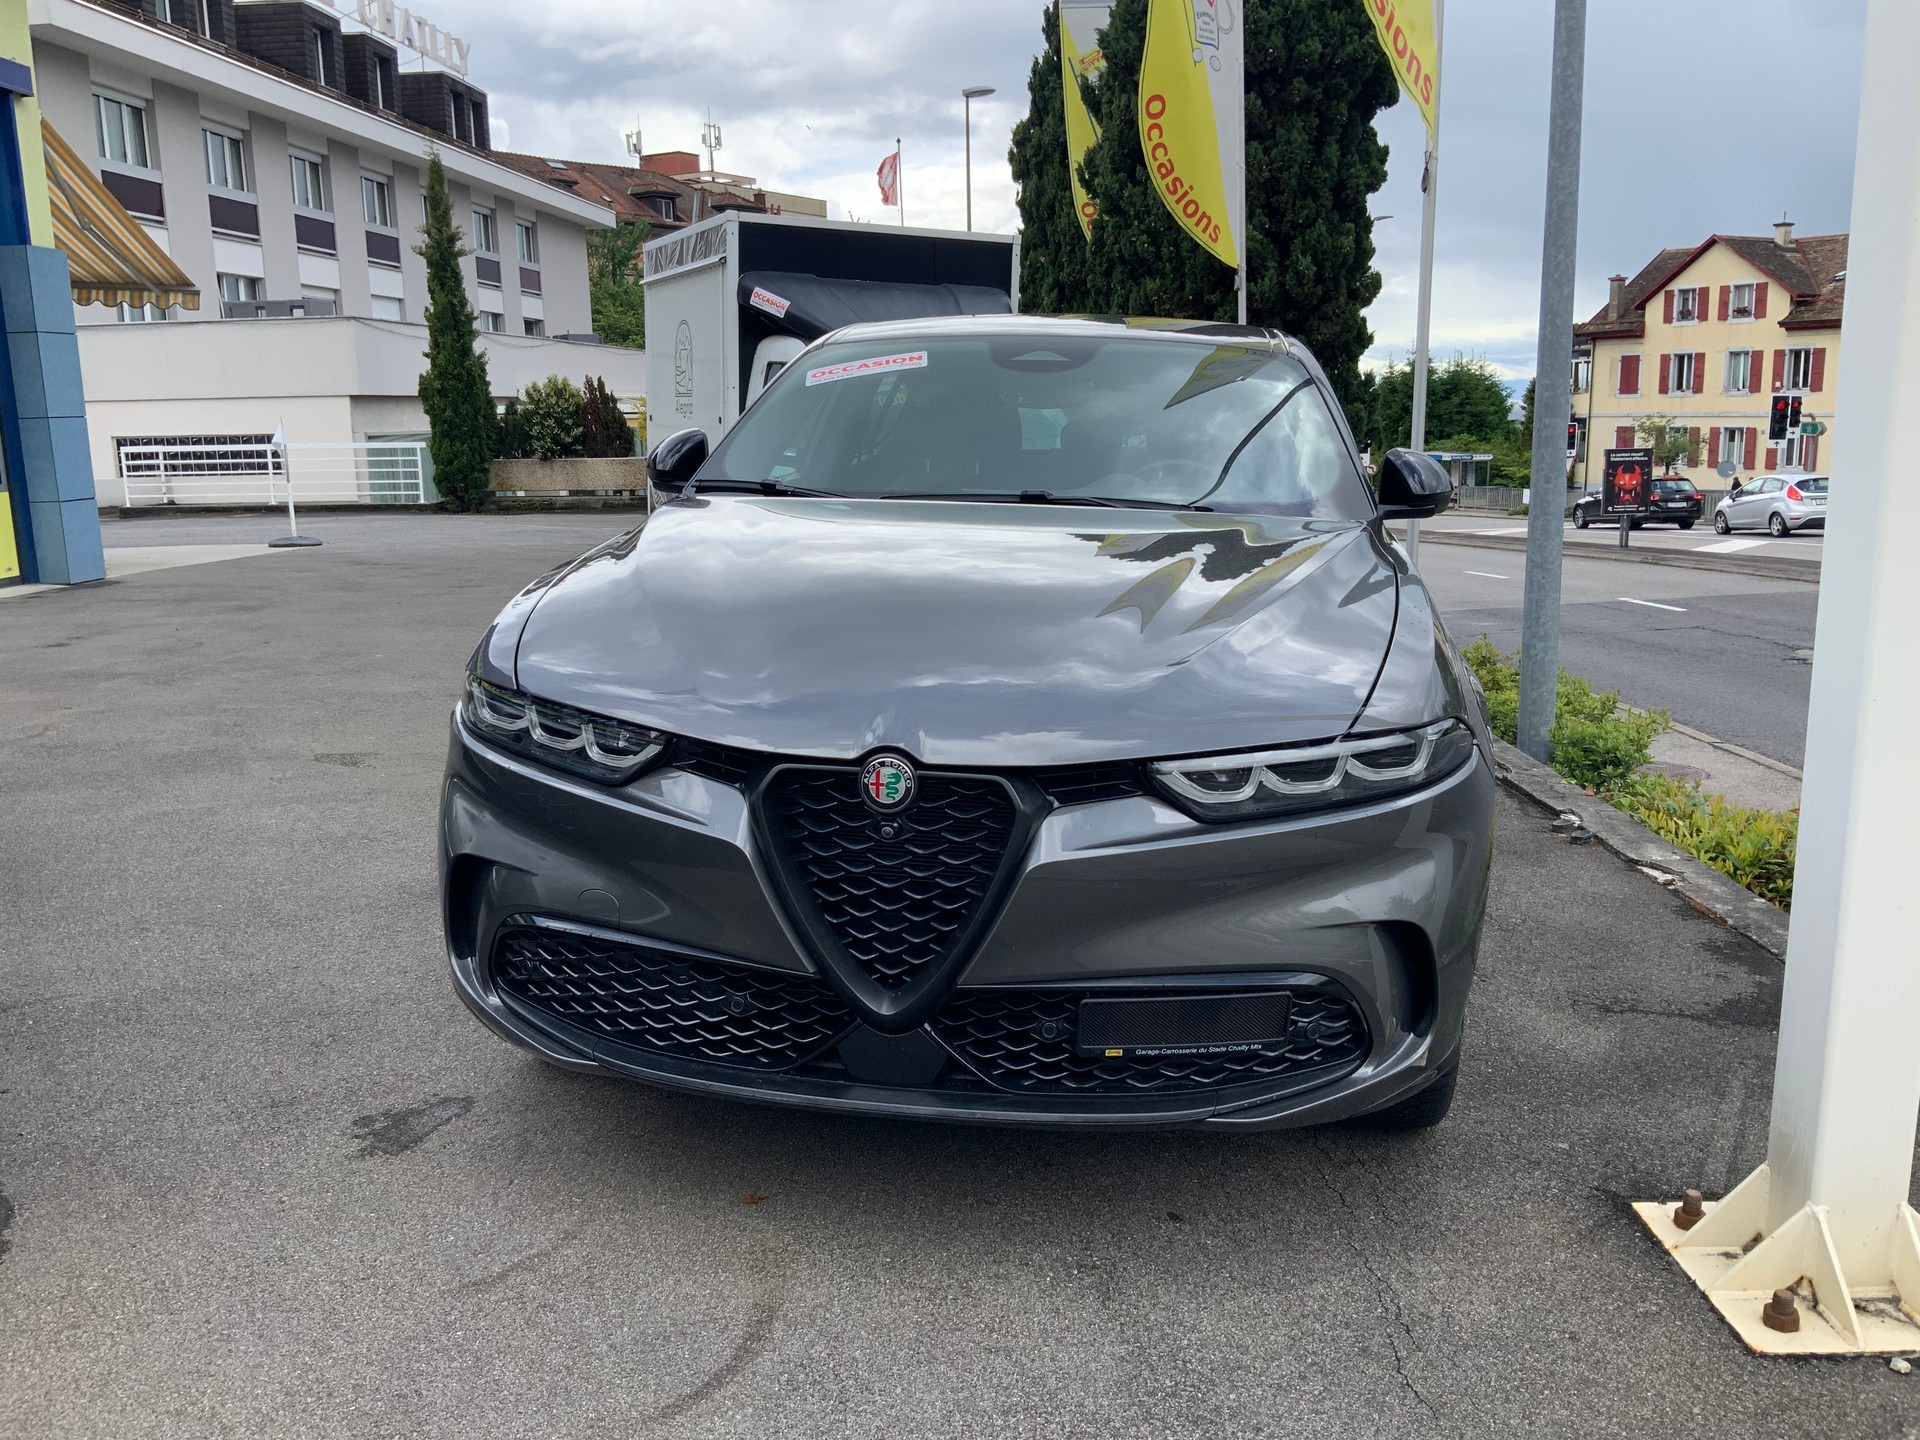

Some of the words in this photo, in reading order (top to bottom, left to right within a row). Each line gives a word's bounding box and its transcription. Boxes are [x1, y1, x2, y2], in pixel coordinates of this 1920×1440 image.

[356, 0, 471, 76] CHAILLY
[1144, 93, 1222, 244] Occasions
[753, 291, 787, 311] OCCASION
[811, 355, 923, 378] OCCASION
[863, 763, 881, 785] ALFA
[884, 760, 912, 787] ROMEO
[1135, 1047, 1198, 1055] Garage-Carrosserie
[1228, 1044, 1249, 1052] Chailly
